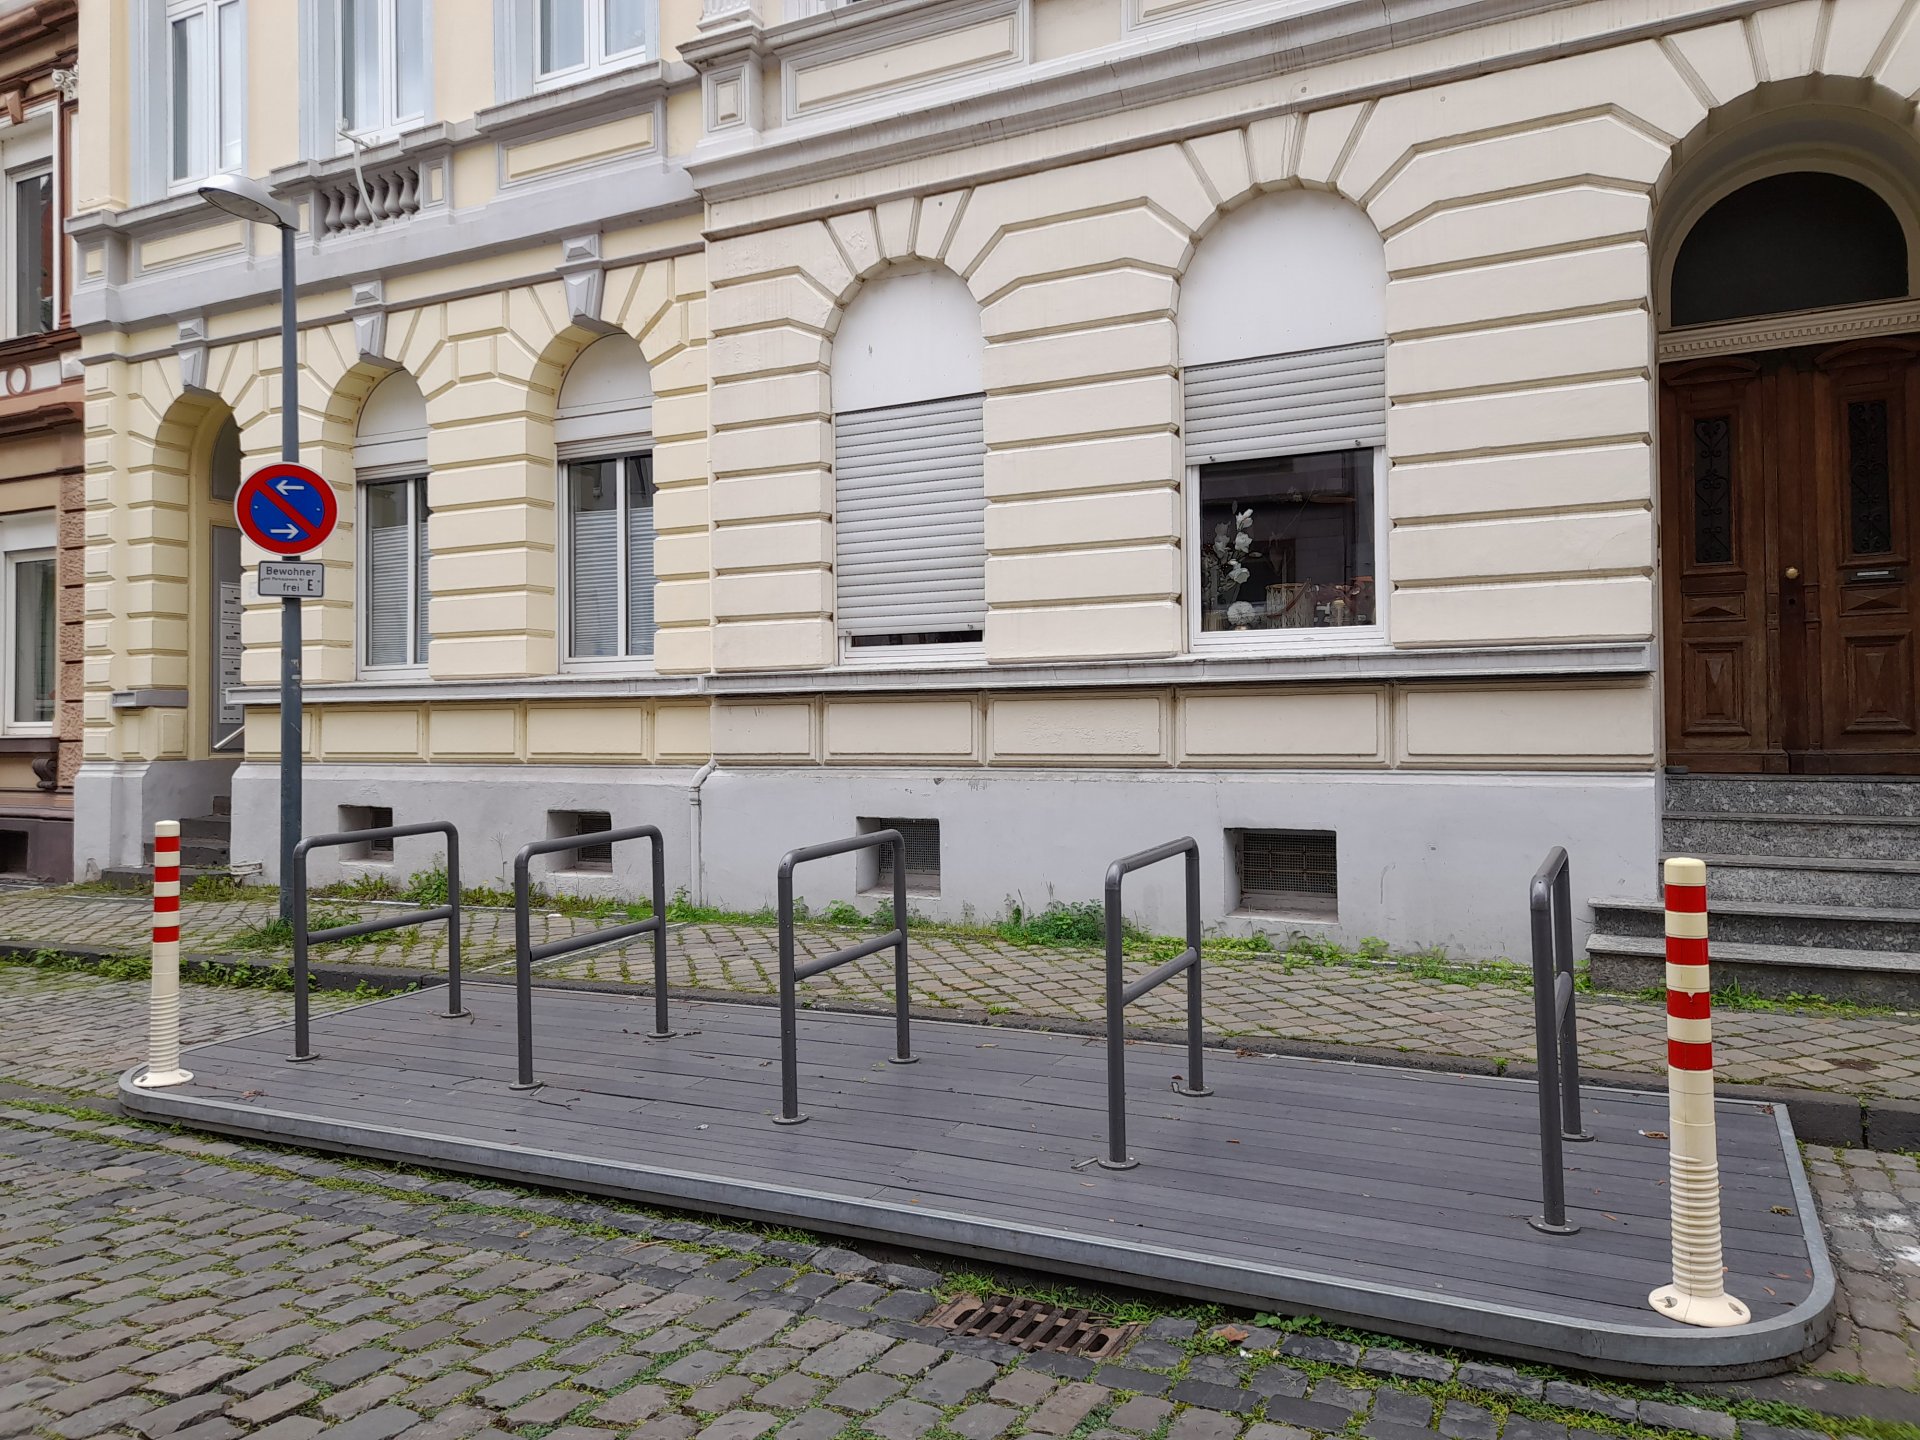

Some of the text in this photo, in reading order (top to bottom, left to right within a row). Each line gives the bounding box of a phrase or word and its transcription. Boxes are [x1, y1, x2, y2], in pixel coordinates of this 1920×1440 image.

[266, 566, 316, 576] Bewohner
[283, 583, 300, 592] frei
[307, 579, 314, 591] E
